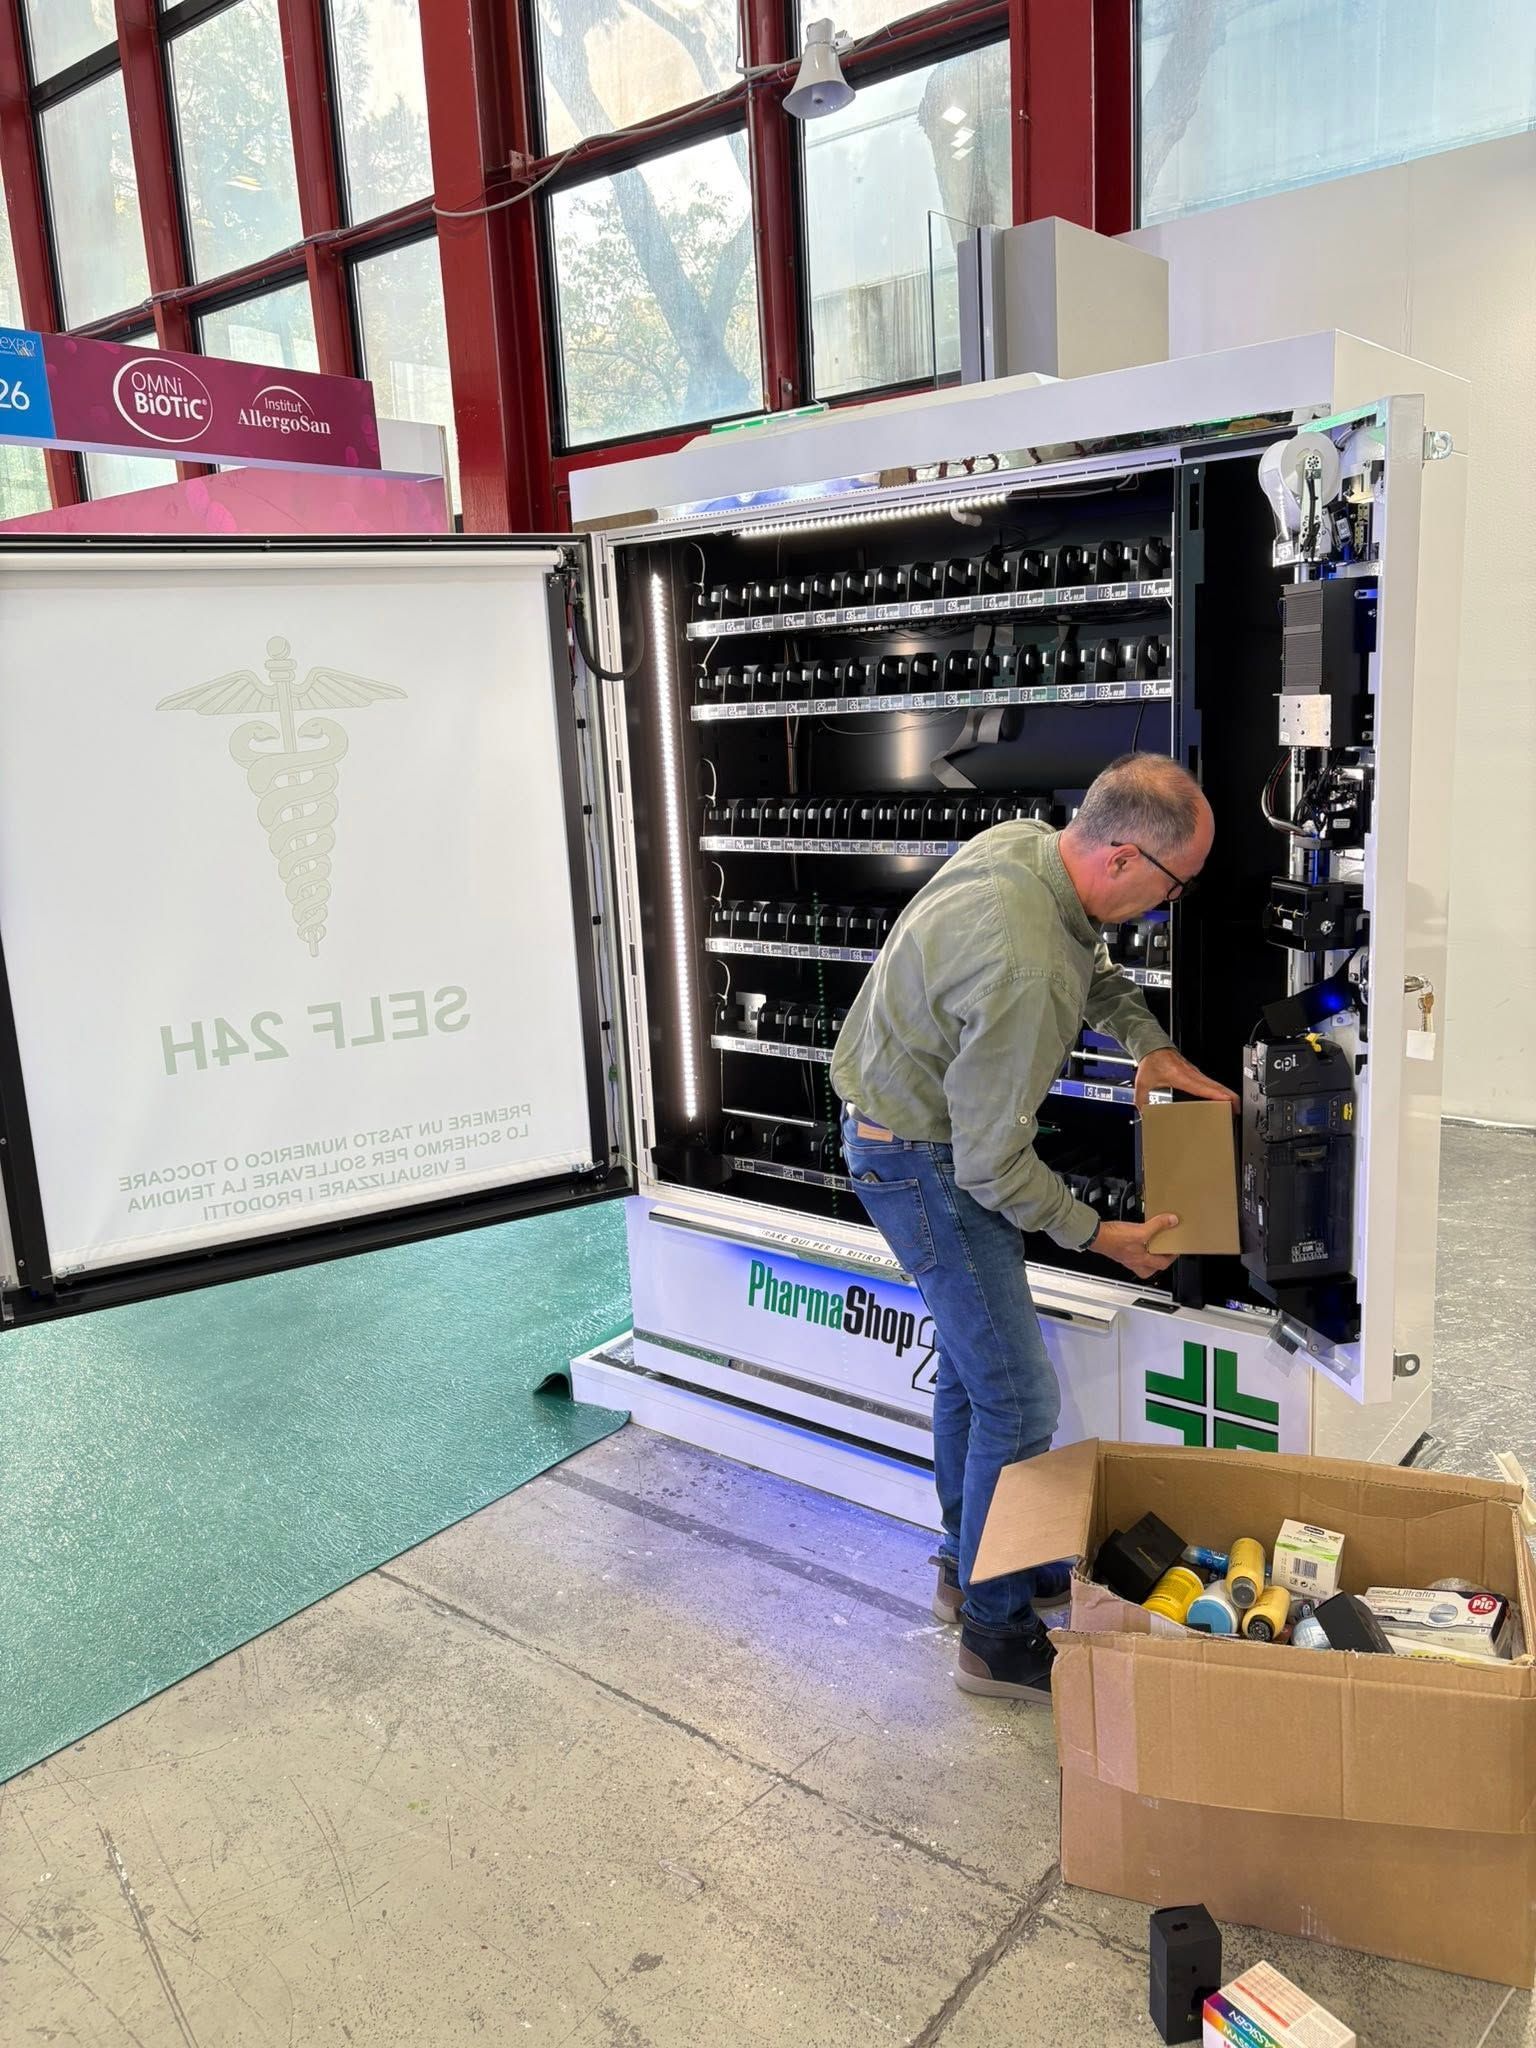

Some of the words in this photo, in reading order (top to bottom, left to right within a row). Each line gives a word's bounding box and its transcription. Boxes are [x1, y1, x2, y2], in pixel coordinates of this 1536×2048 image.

[264, 397, 302, 414] Institut
[237, 408, 332, 435] AllergoSan
[1273, 1053, 1297, 1072] cpi
[790, 1236, 810, 1247] QUI
[813, 1241, 832, 1251] PER
[833, 1246, 843, 1254] IL
[847, 1250, 882, 1263] RITIRO
[884, 1258, 901, 1268] DE
